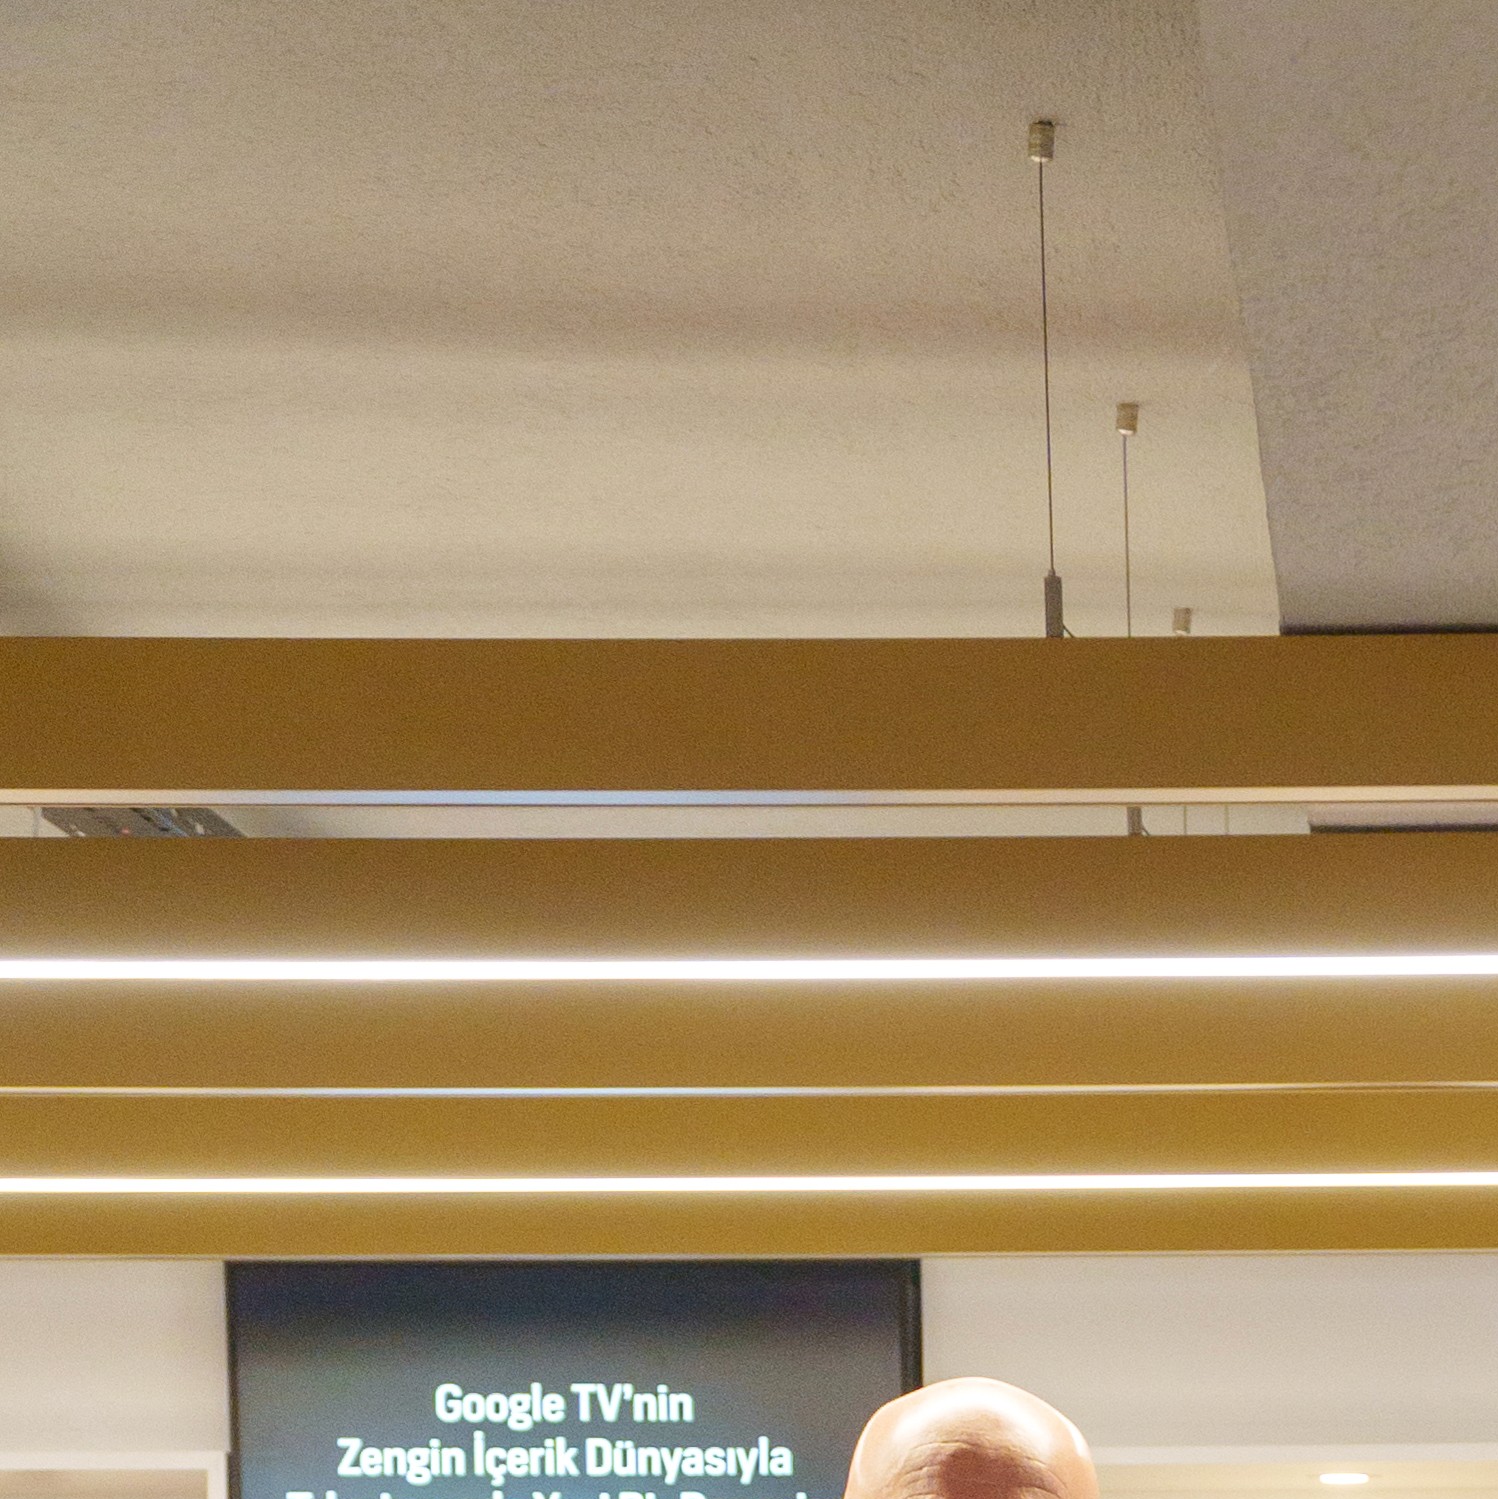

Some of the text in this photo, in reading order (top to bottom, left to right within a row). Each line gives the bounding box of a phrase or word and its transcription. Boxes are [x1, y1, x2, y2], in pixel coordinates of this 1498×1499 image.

[435, 1382, 694, 1432] Google TV'nin
[337, 1430, 794, 1487] Zengin İçerik Dünyasıyla
